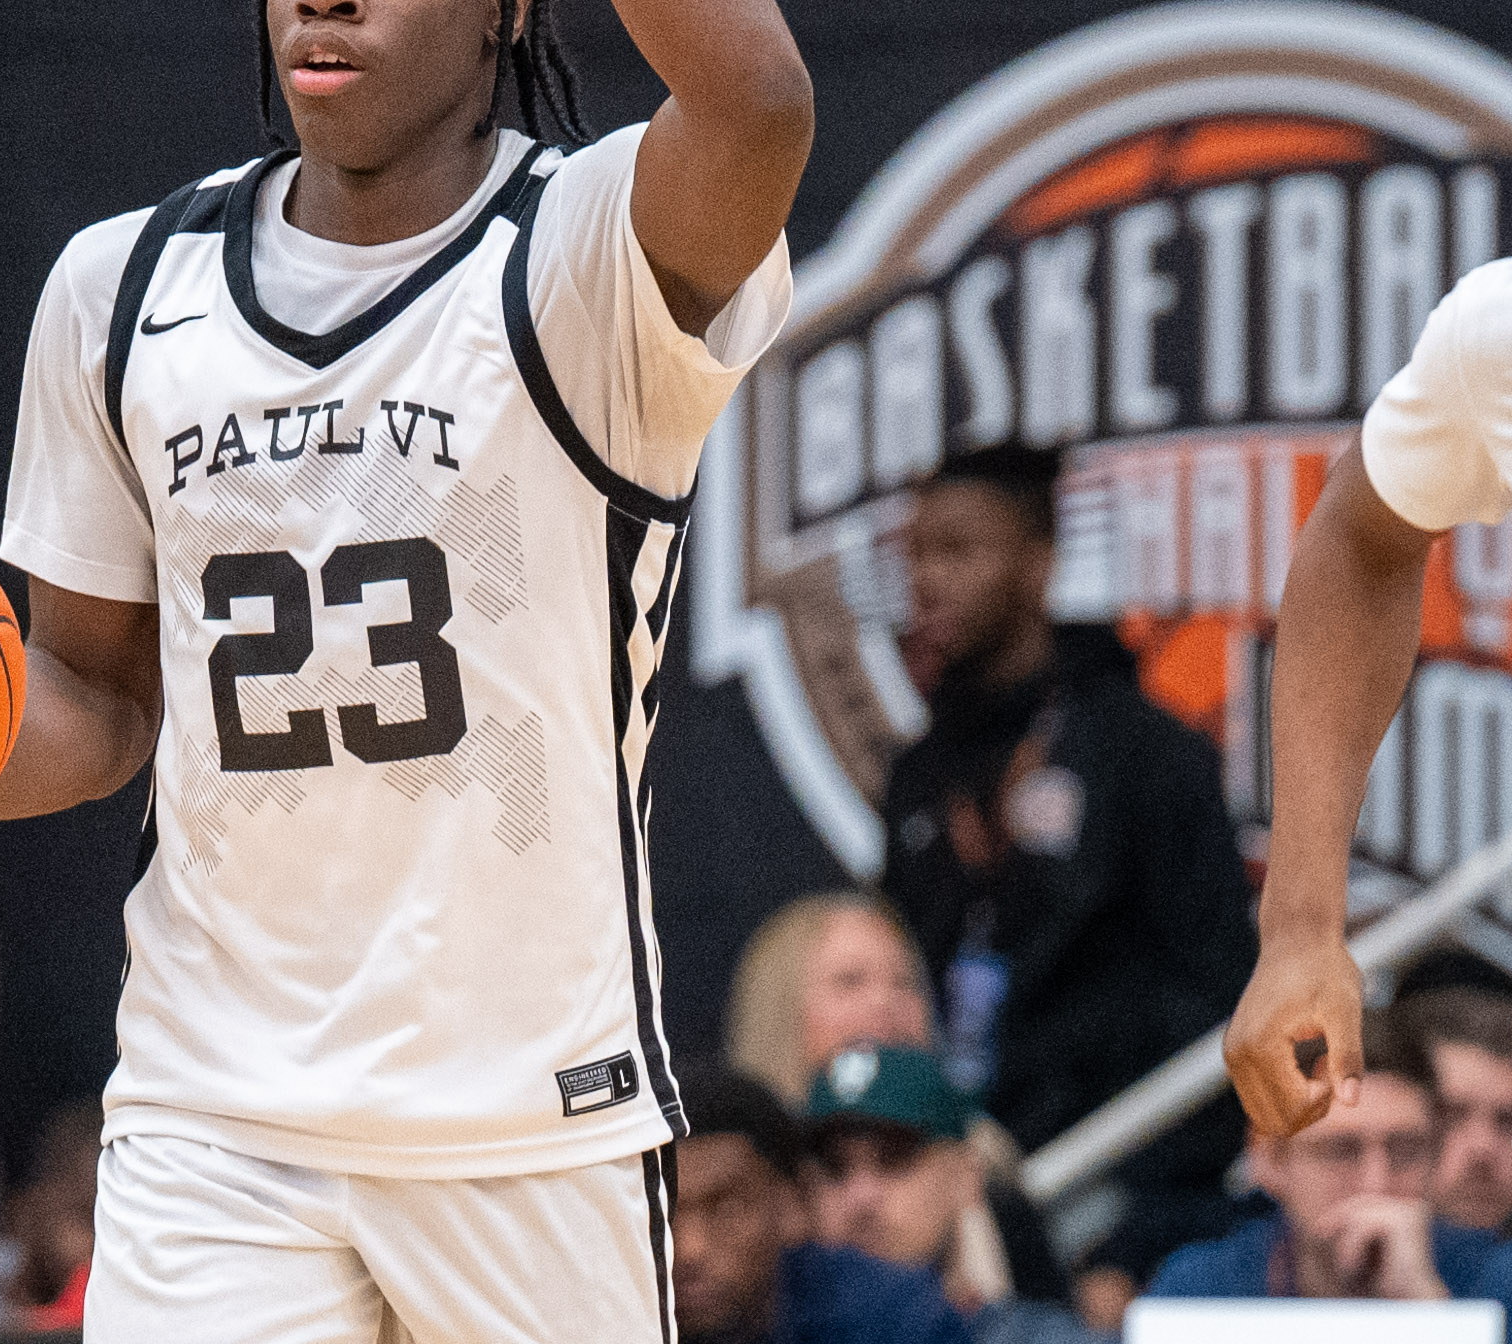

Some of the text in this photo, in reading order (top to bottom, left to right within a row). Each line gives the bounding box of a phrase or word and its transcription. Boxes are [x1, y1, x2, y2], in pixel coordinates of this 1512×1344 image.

[164, 399, 460, 498] PAUL VI
[200, 536, 468, 773] 23
[619, 1068, 631, 1089] L
